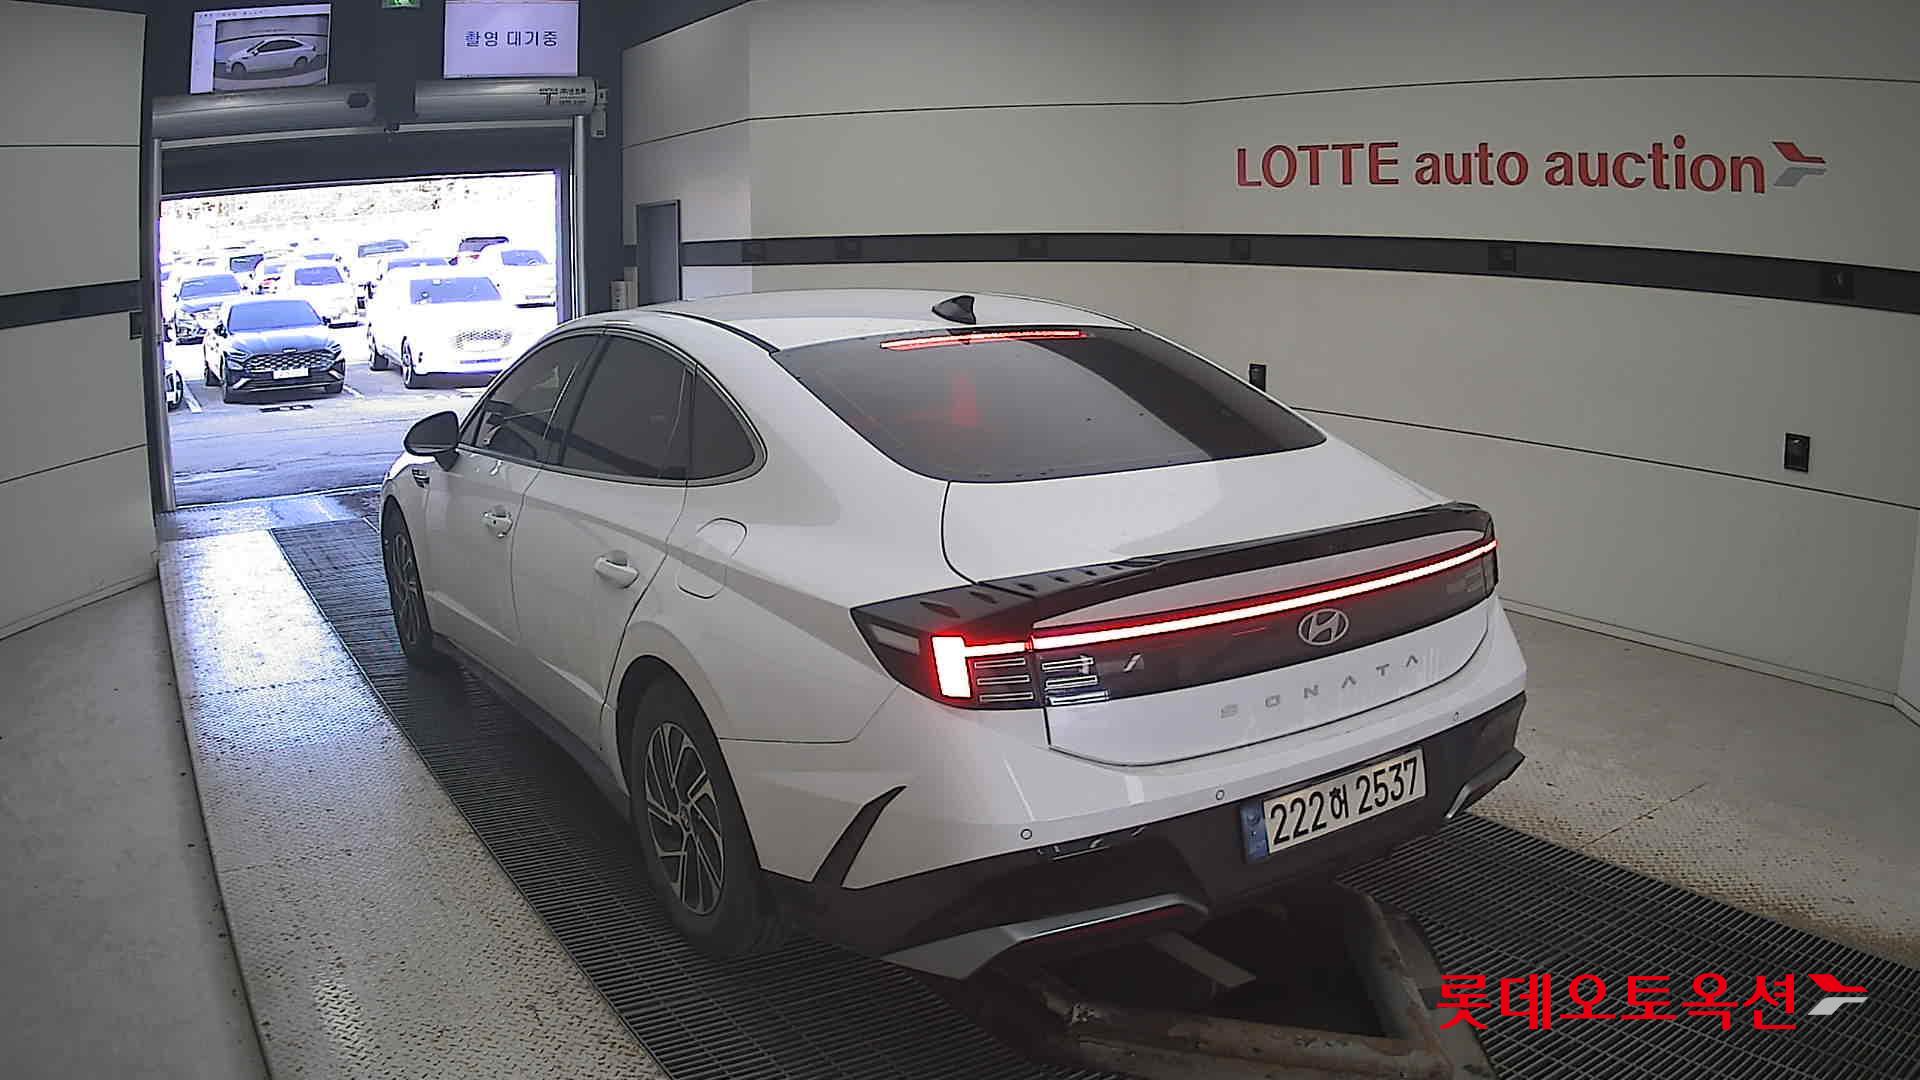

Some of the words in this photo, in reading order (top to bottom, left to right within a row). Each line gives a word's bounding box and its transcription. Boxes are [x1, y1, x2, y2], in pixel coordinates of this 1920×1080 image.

[507, 31, 558, 47] 대기중
[1237, 142, 1400, 189] LOTTE
[1415, 142, 1529, 187] auto
[1544, 134, 1766, 194] auction
[1219, 654, 1420, 719] SONATA
[1270, 783, 1350, 846] 222허
[1355, 756, 1418, 816] 2537
